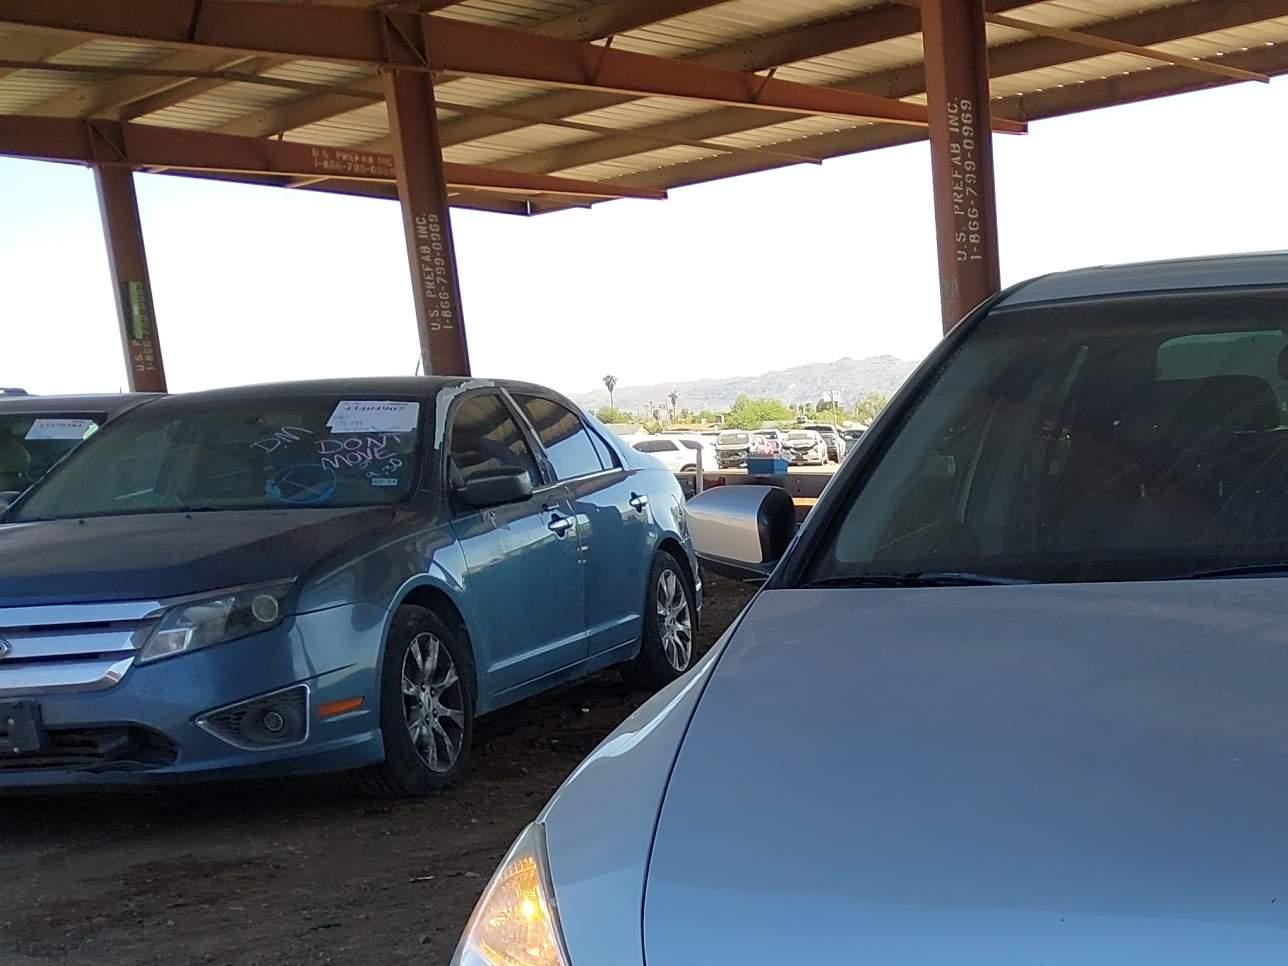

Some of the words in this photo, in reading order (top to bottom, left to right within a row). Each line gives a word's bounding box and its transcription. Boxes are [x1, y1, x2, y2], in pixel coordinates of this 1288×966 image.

[950, 143, 965, 215] PREFAB
[961, 99, 982, 260] 1-866-799-0969
[420, 245, 437, 298] PREFAB
[321, 448, 397, 470] MOVE
